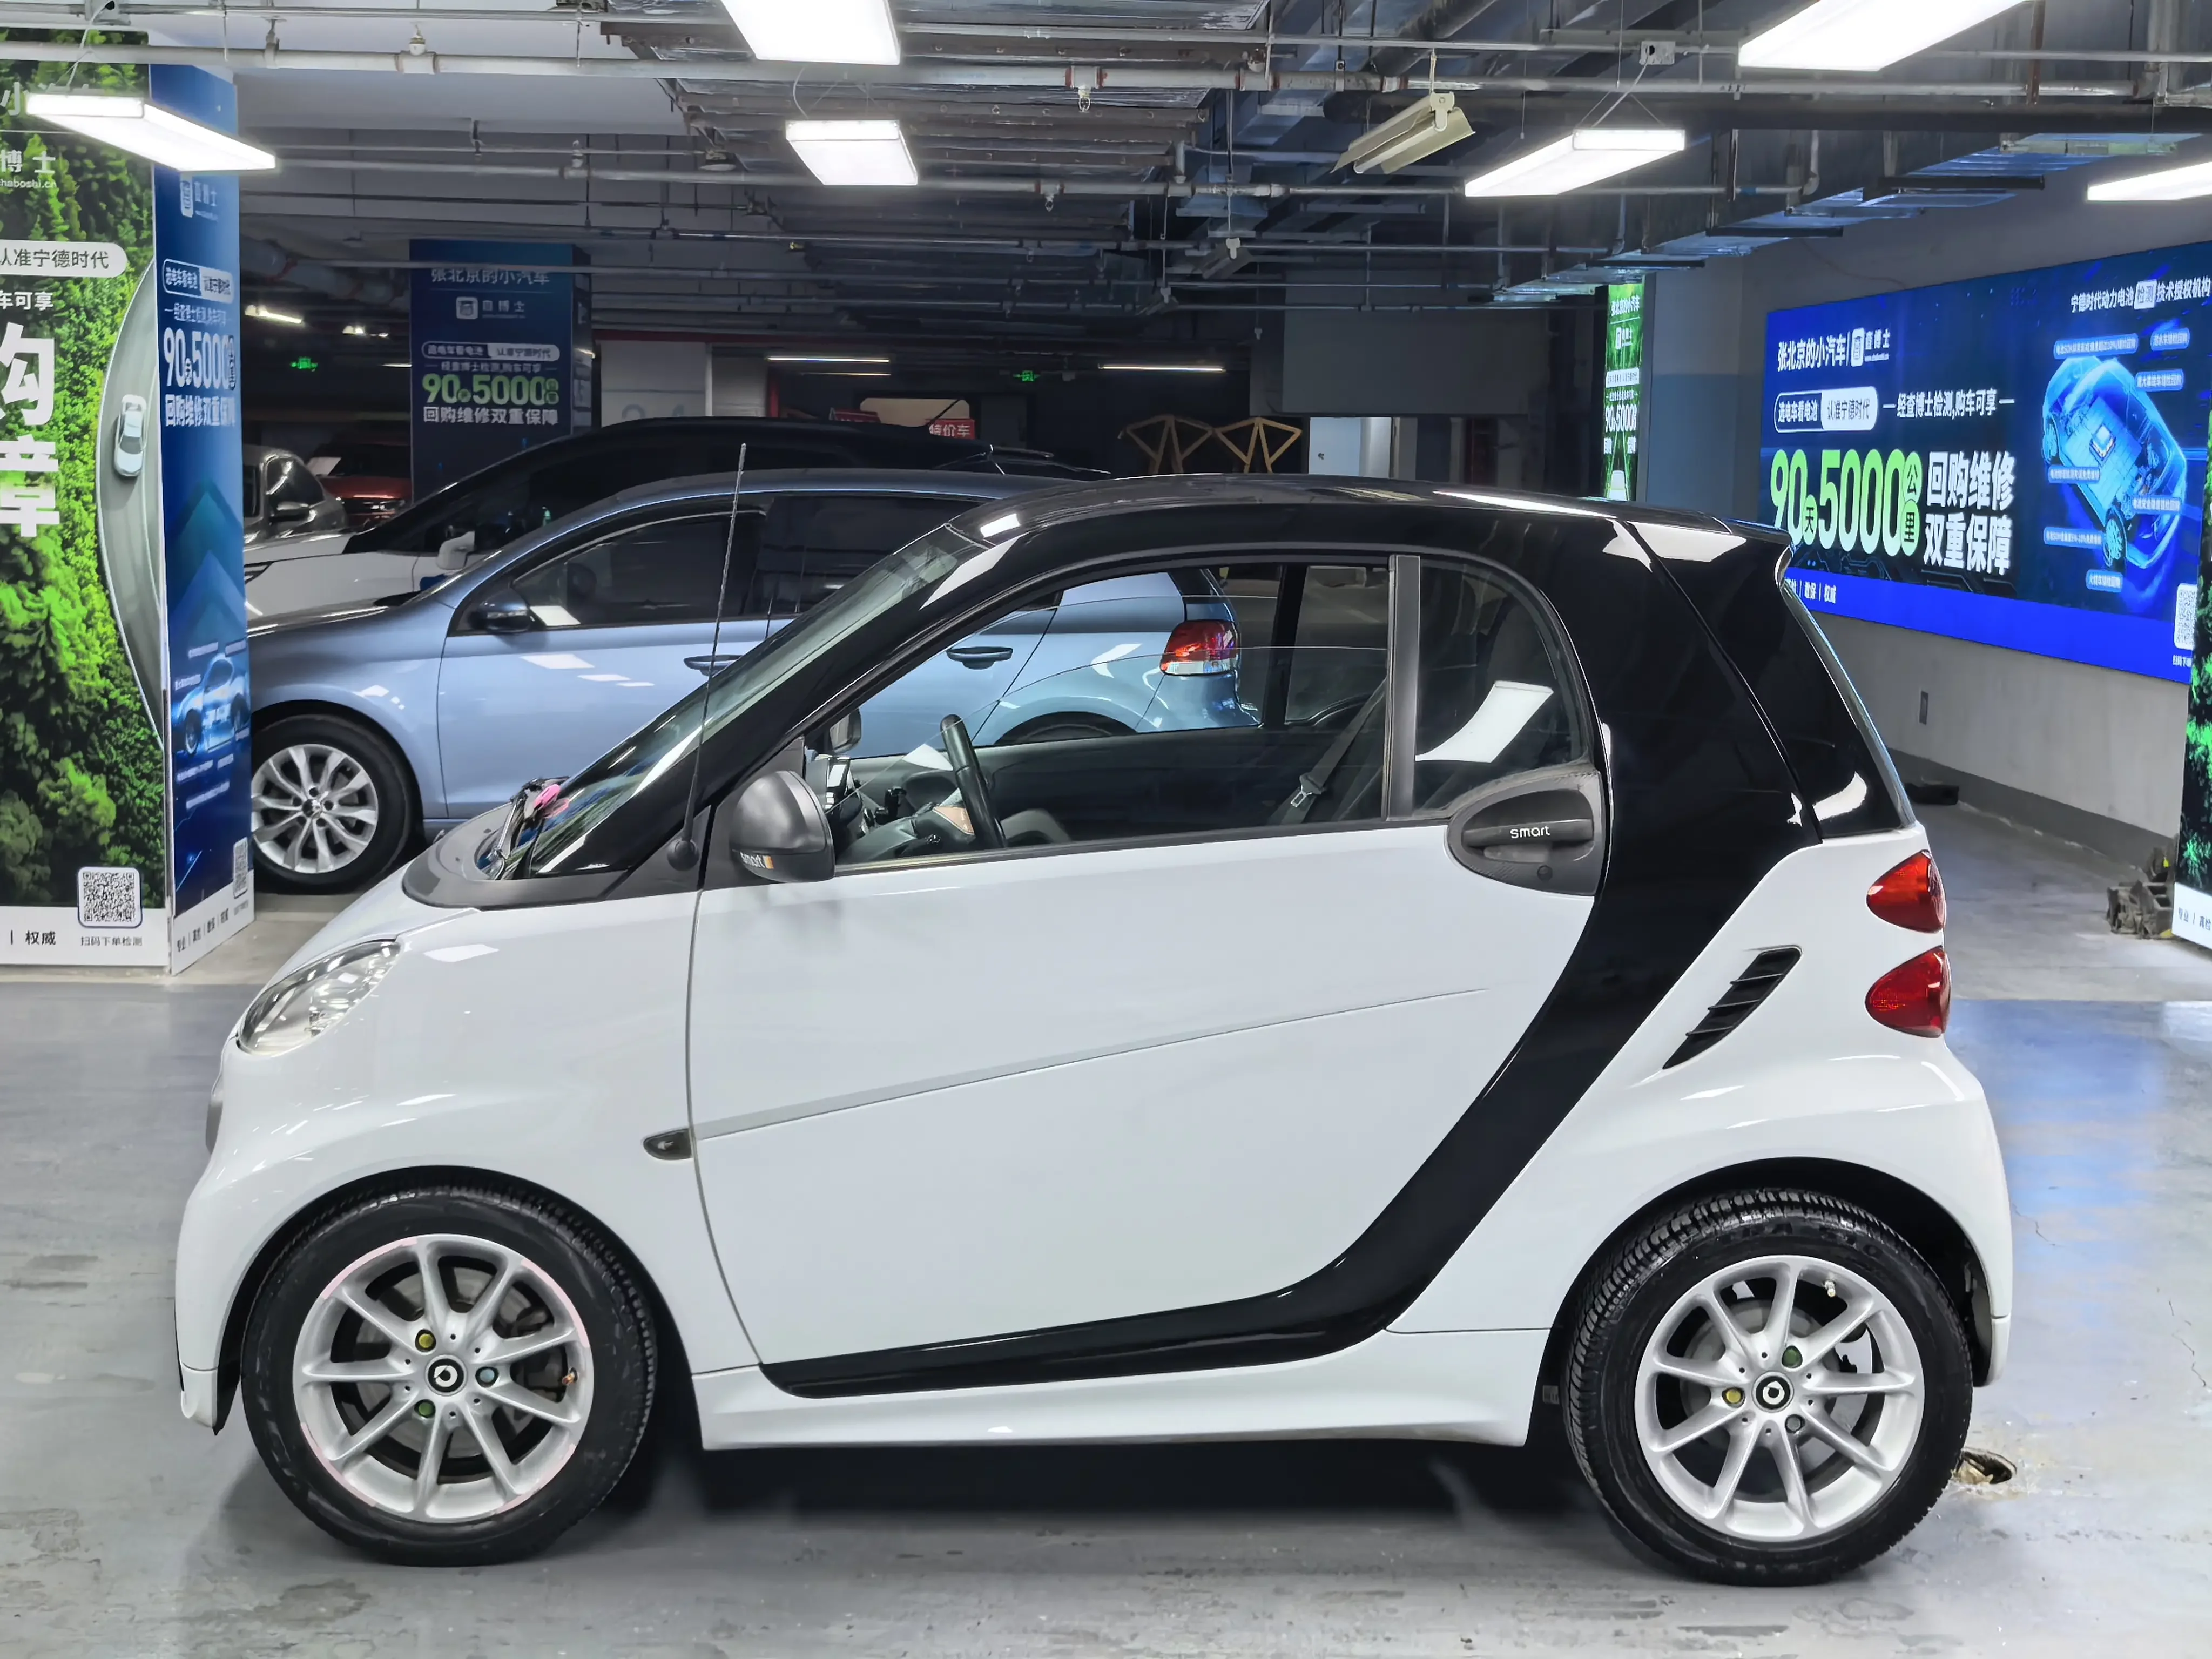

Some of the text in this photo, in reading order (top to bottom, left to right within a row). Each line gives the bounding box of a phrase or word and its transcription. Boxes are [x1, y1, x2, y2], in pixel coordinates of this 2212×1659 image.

[1778, 333, 1846, 372] 张北京的小汽车
[423, 406, 558, 425] 回购维修双重保障
[1926, 450, 2016, 511] 回购维修
[1923, 512, 2014, 576] 双重保障
[1510, 826, 1550, 839] smart
[25, 930, 56, 945] 权威
